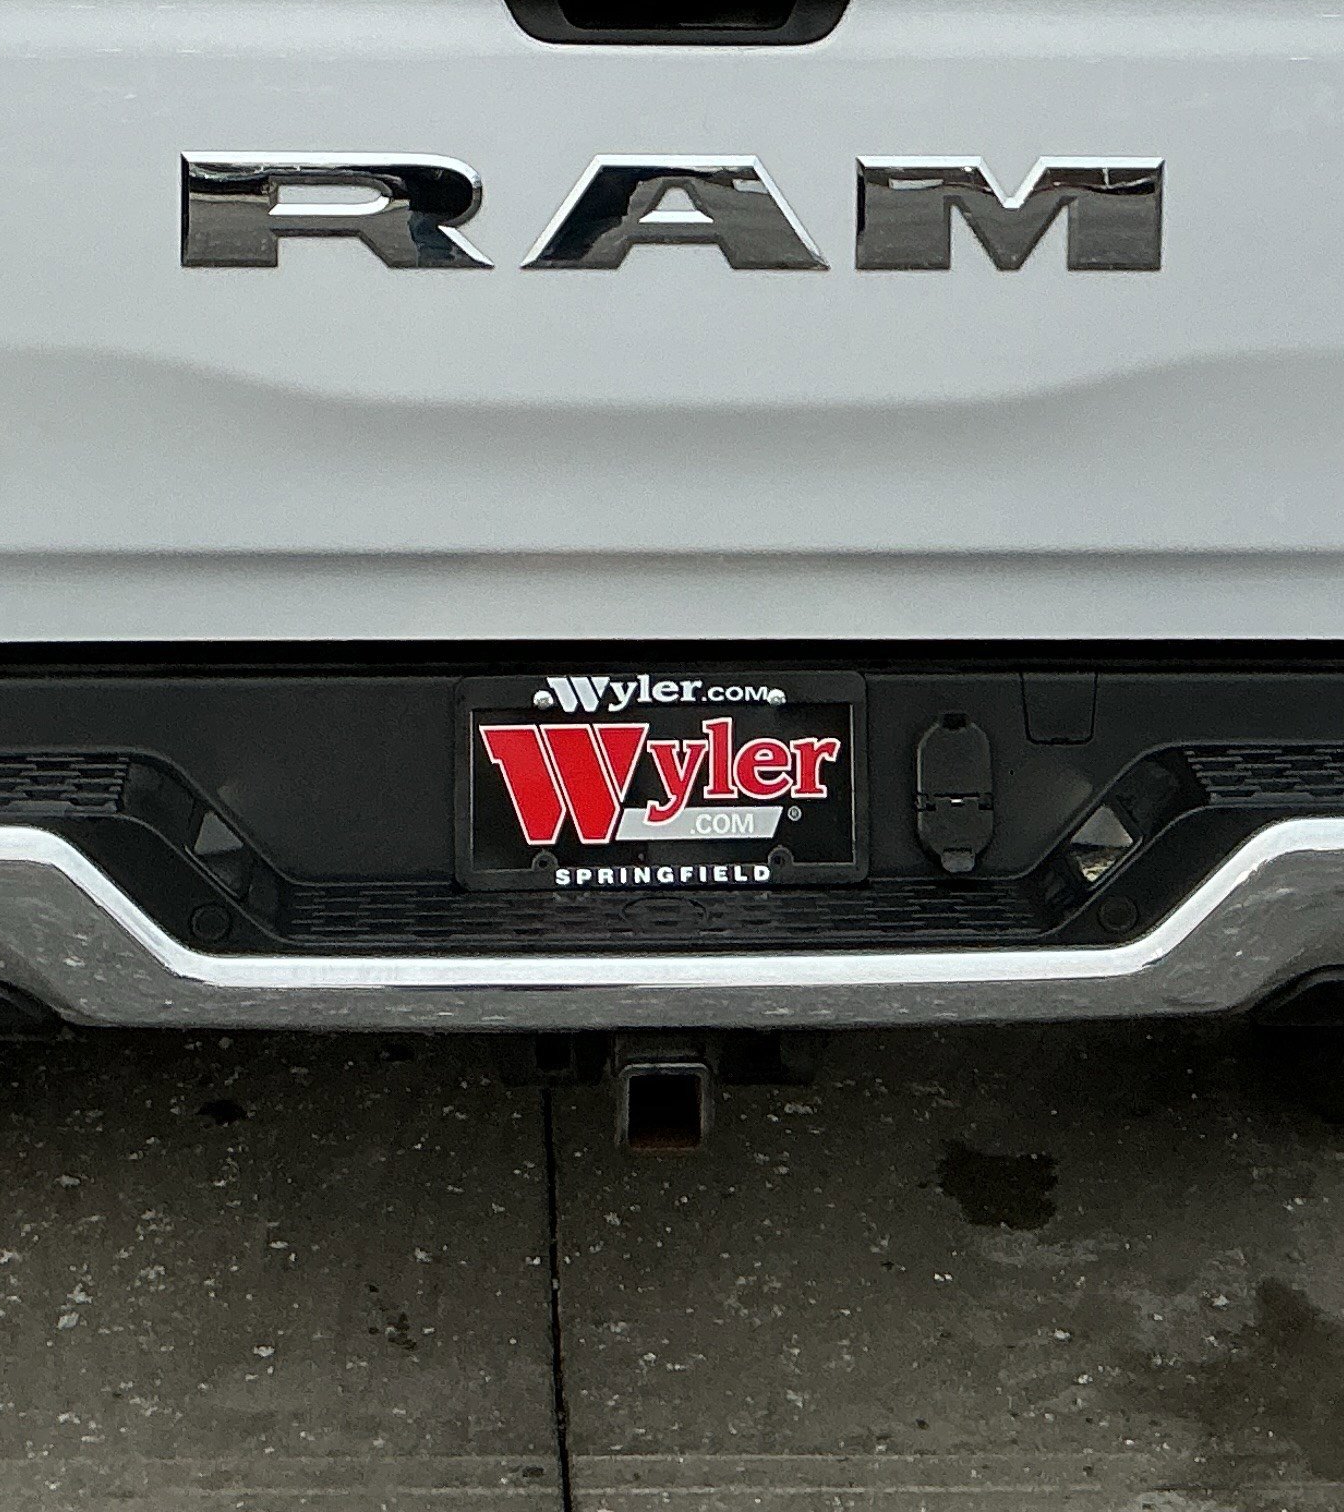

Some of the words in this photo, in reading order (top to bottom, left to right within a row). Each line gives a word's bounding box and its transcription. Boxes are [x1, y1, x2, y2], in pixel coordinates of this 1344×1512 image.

[180, 150, 1166, 271] RAM
[479, 717, 841, 845] Wyler
[555, 865, 772, 886] SPRINGFIELD
